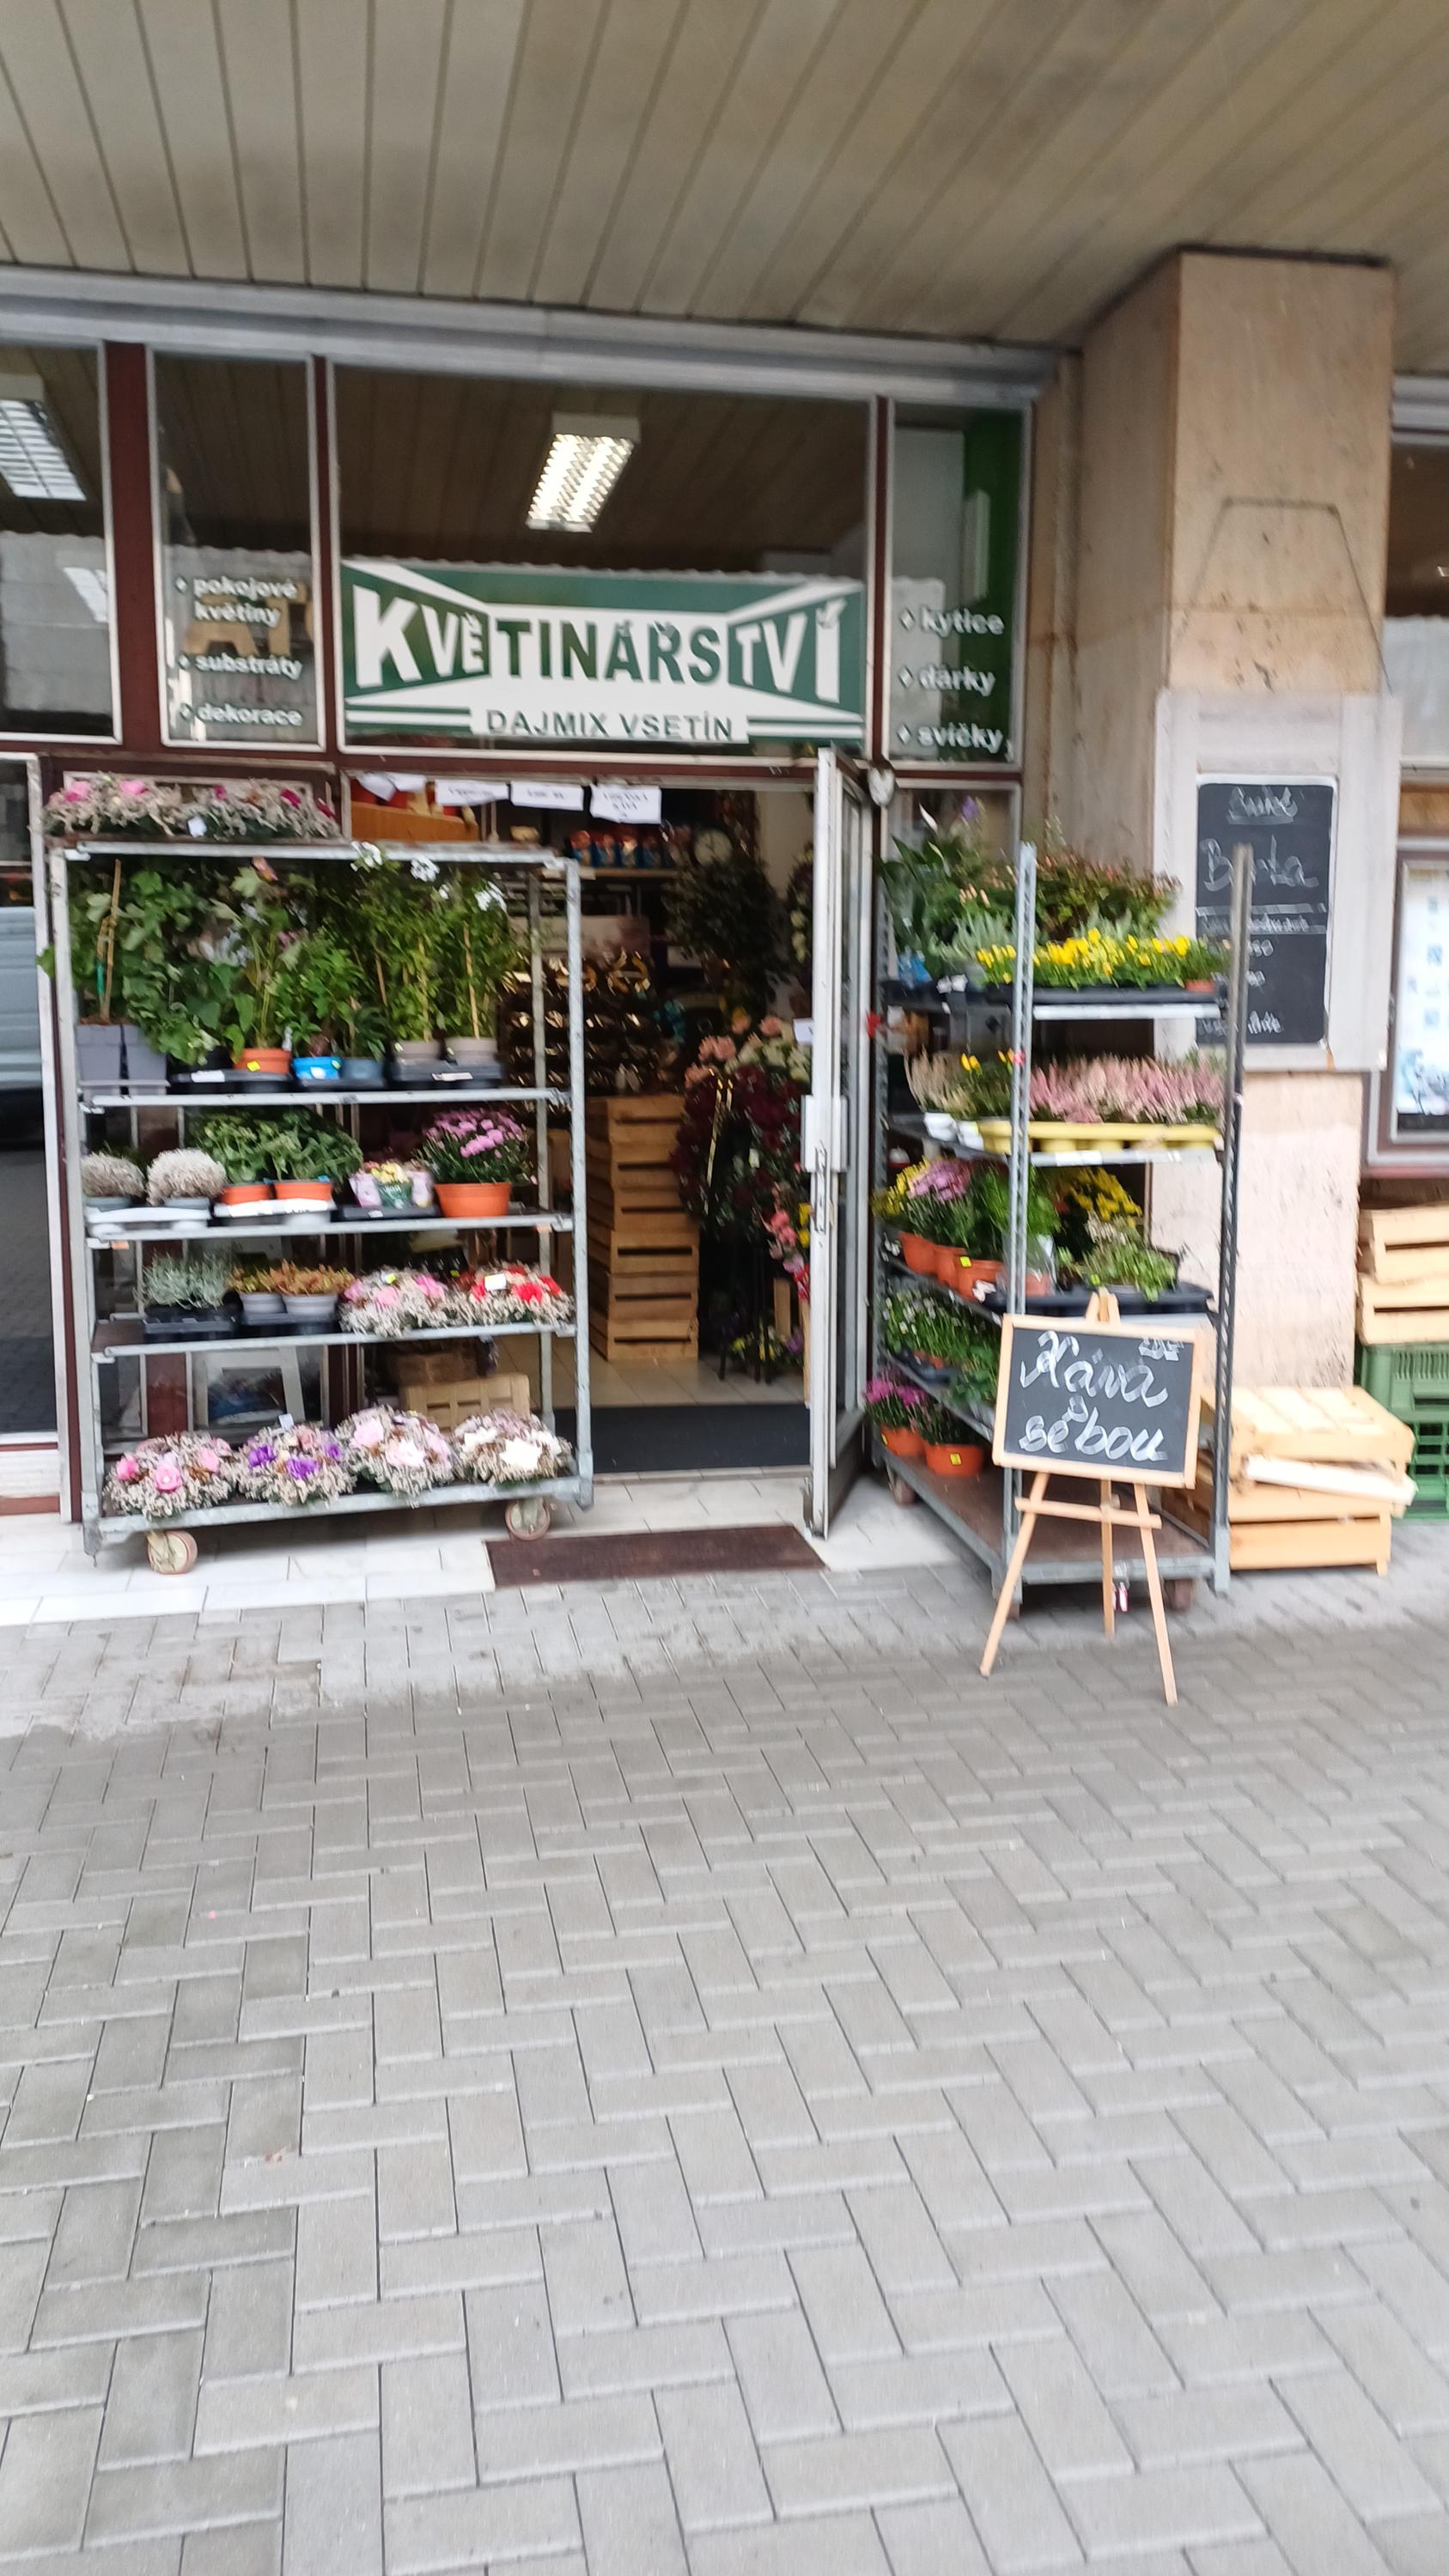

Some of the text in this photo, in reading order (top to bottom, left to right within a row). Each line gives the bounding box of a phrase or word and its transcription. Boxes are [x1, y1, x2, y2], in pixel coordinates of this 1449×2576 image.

[193, 574, 297, 600] pokojové
[194, 601, 281, 628] květiny
[921, 607, 1005, 637] kytice
[352, 584, 848, 703] KVĚTINÁŘSTVÍ
[194, 652, 302, 680] substráty
[919, 665, 996, 697] dárky
[197, 702, 302, 726] dekorace
[486, 709, 734, 742] DAJMIX VSETÍN
[917, 721, 1003, 755] svíčky
[1019, 1406, 1169, 1462] sebou
